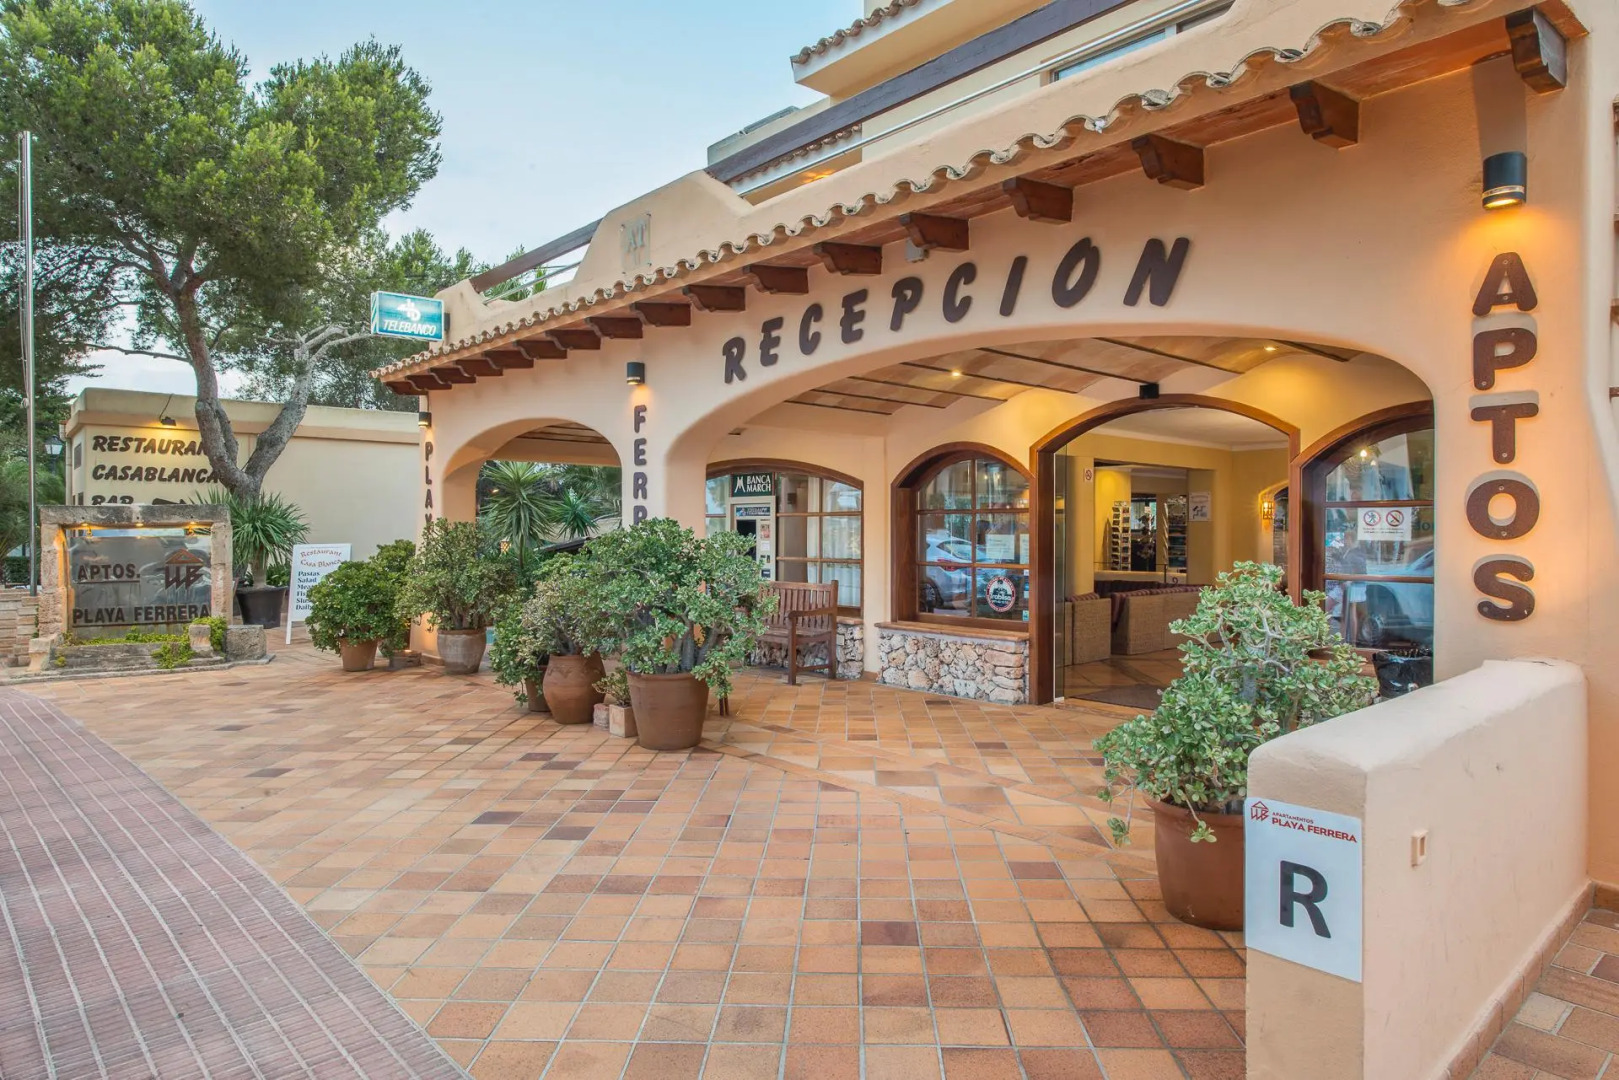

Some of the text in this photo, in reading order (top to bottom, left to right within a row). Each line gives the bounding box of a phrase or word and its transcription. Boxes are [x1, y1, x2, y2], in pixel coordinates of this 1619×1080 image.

[722, 237, 1190, 384] RECEPCION
[383, 320, 436, 336] TELEBANCO
[1466, 252, 1540, 622] APTOS
[92, 464, 221, 483] CASABLANCA
[746, 474, 771, 485] BANCA
[746, 483, 772, 493] MARCH
[300, 549, 342, 558] Restaurant
[77, 563, 141, 581] APTOS.
[300, 559, 317, 568] Casa
[72, 604, 210, 624] PLAYA FERRERA
[1272, 811, 1314, 824] APARTAMENTOS
[1271, 816, 1358, 843] PLAYA FERRERA
[1279, 860, 1332, 939] R
